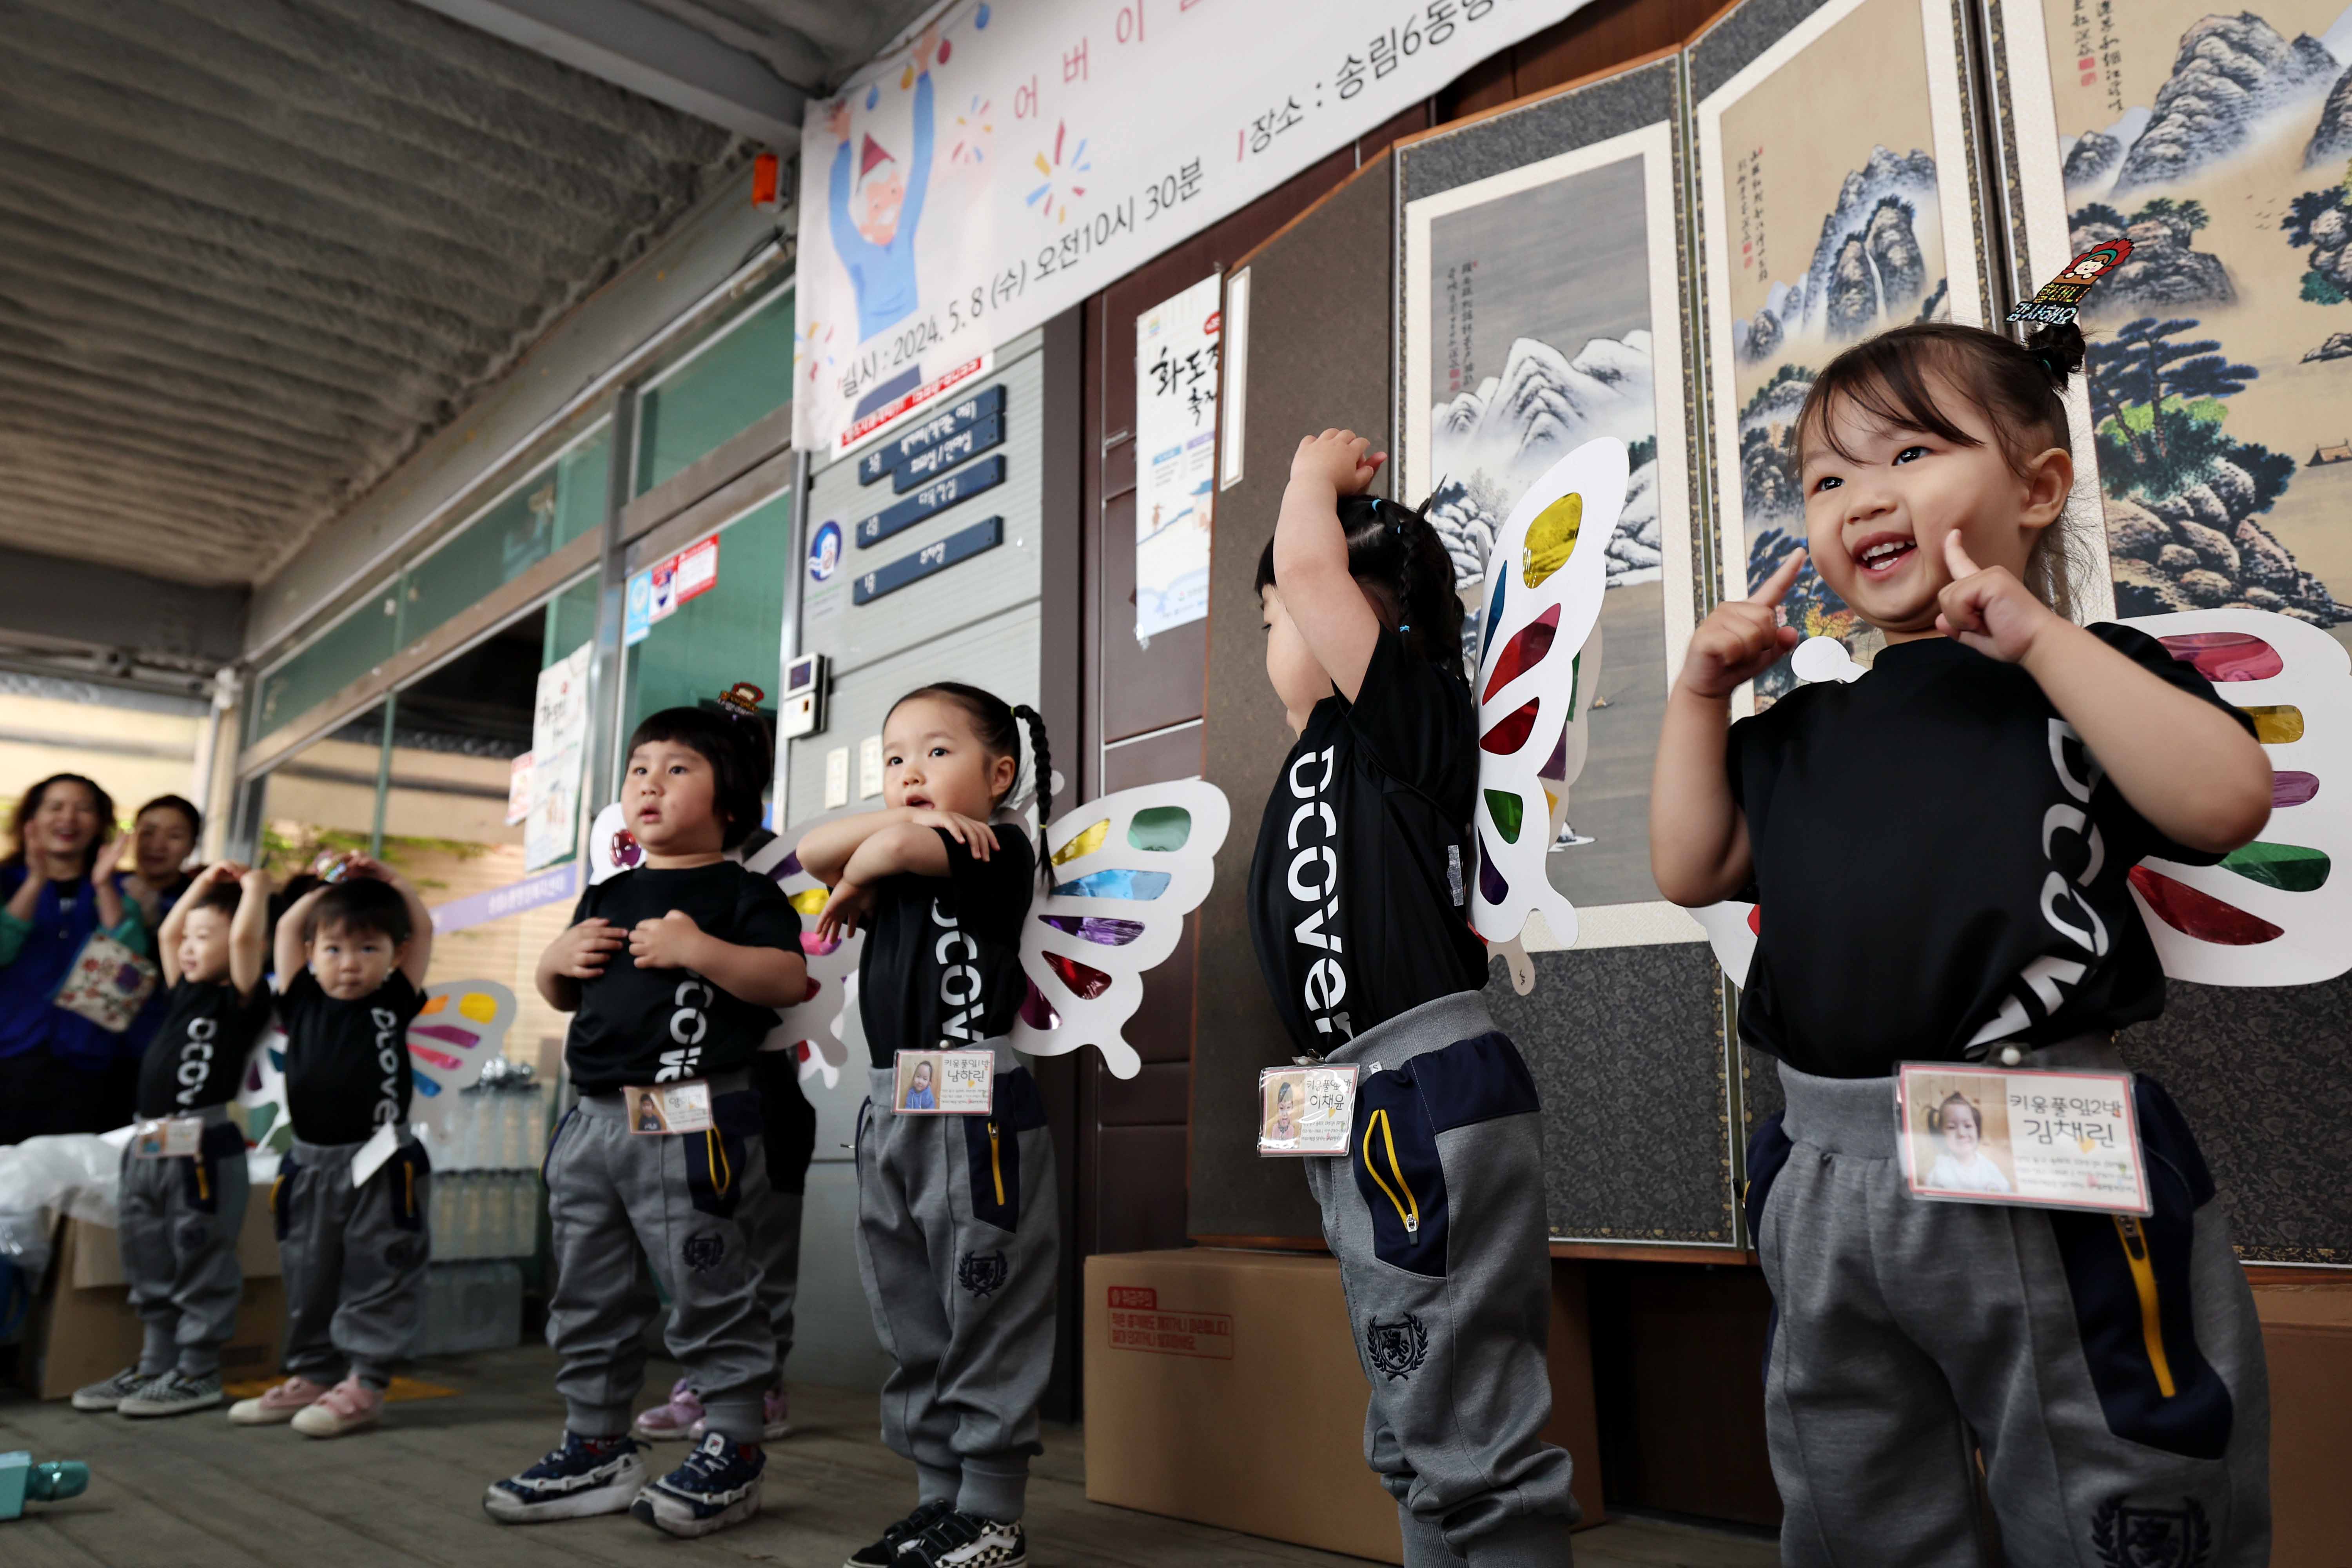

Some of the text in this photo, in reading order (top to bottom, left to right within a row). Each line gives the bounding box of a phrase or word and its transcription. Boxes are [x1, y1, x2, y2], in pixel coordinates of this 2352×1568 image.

[1014, 0, 1203, 119] 어버이
[1249, 95, 1304, 156] 장소
[893, 315, 943, 365] 2024.
[949, 300, 965, 333] 5.
[971, 286, 983, 317] 8
[991, 260, 1026, 310] (수)
[1034, 196, 1134, 281] 오전10시
[1145, 156, 1203, 221] 30분
[947, 1069, 985, 1082] 남하린
[1310, 1093, 1345, 1110] 이채윤
[2023, 1118, 2115, 1149] 김채린
